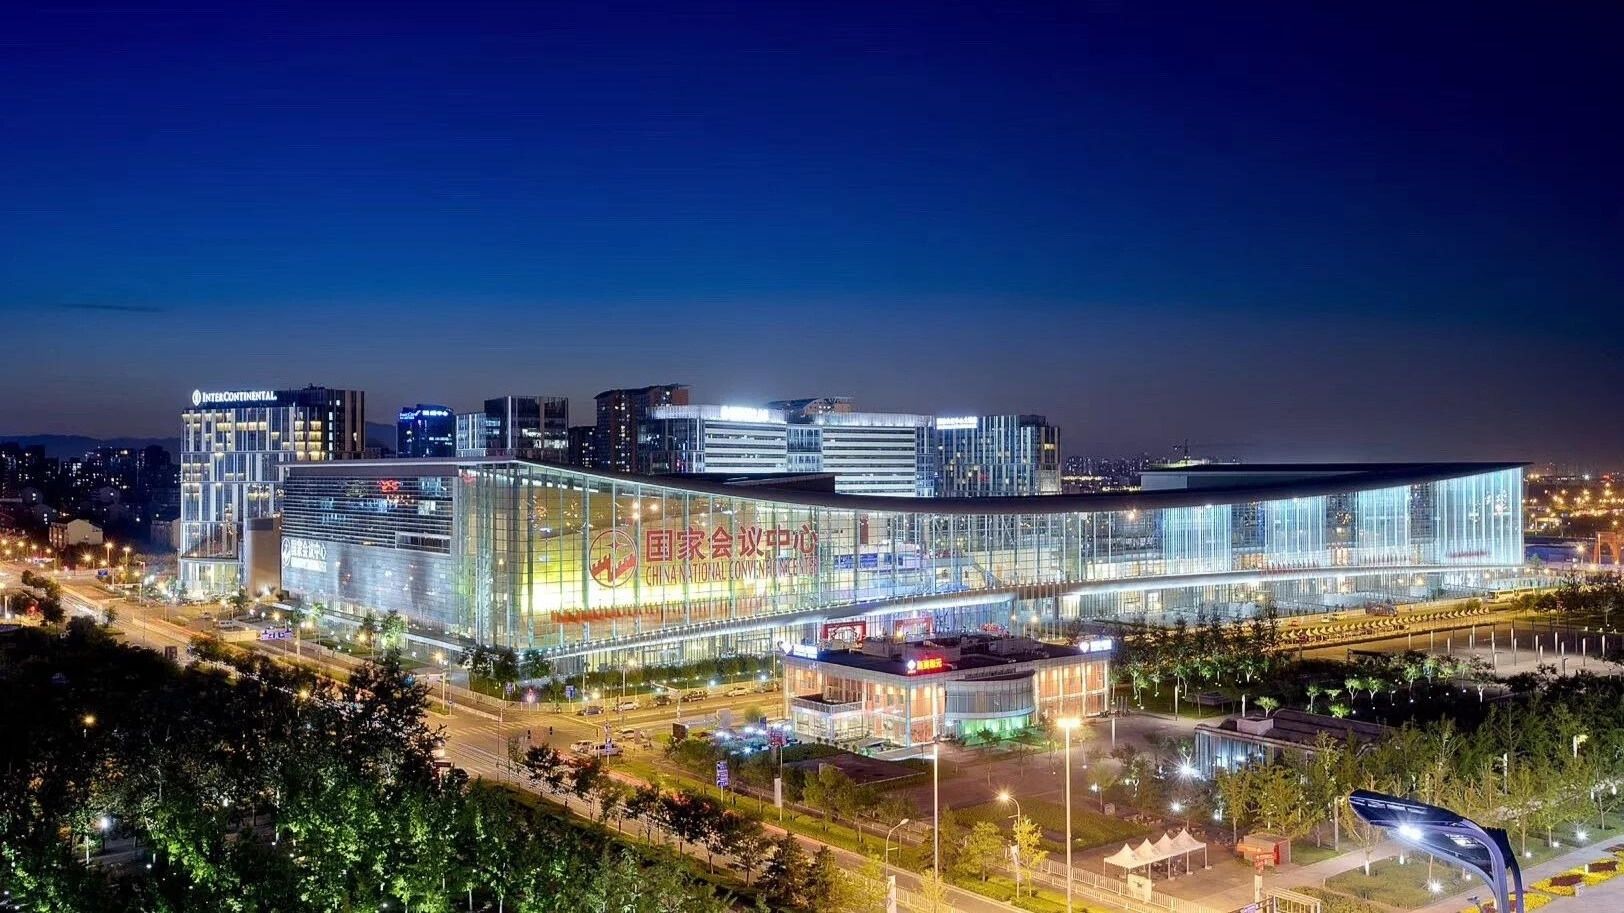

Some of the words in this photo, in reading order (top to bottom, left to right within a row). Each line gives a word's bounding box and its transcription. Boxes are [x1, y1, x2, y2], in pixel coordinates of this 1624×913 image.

[645, 524, 818, 562] 国家会议中心
[646, 565, 677, 587] CHINA
[679, 561, 727, 584] NATIONAL
